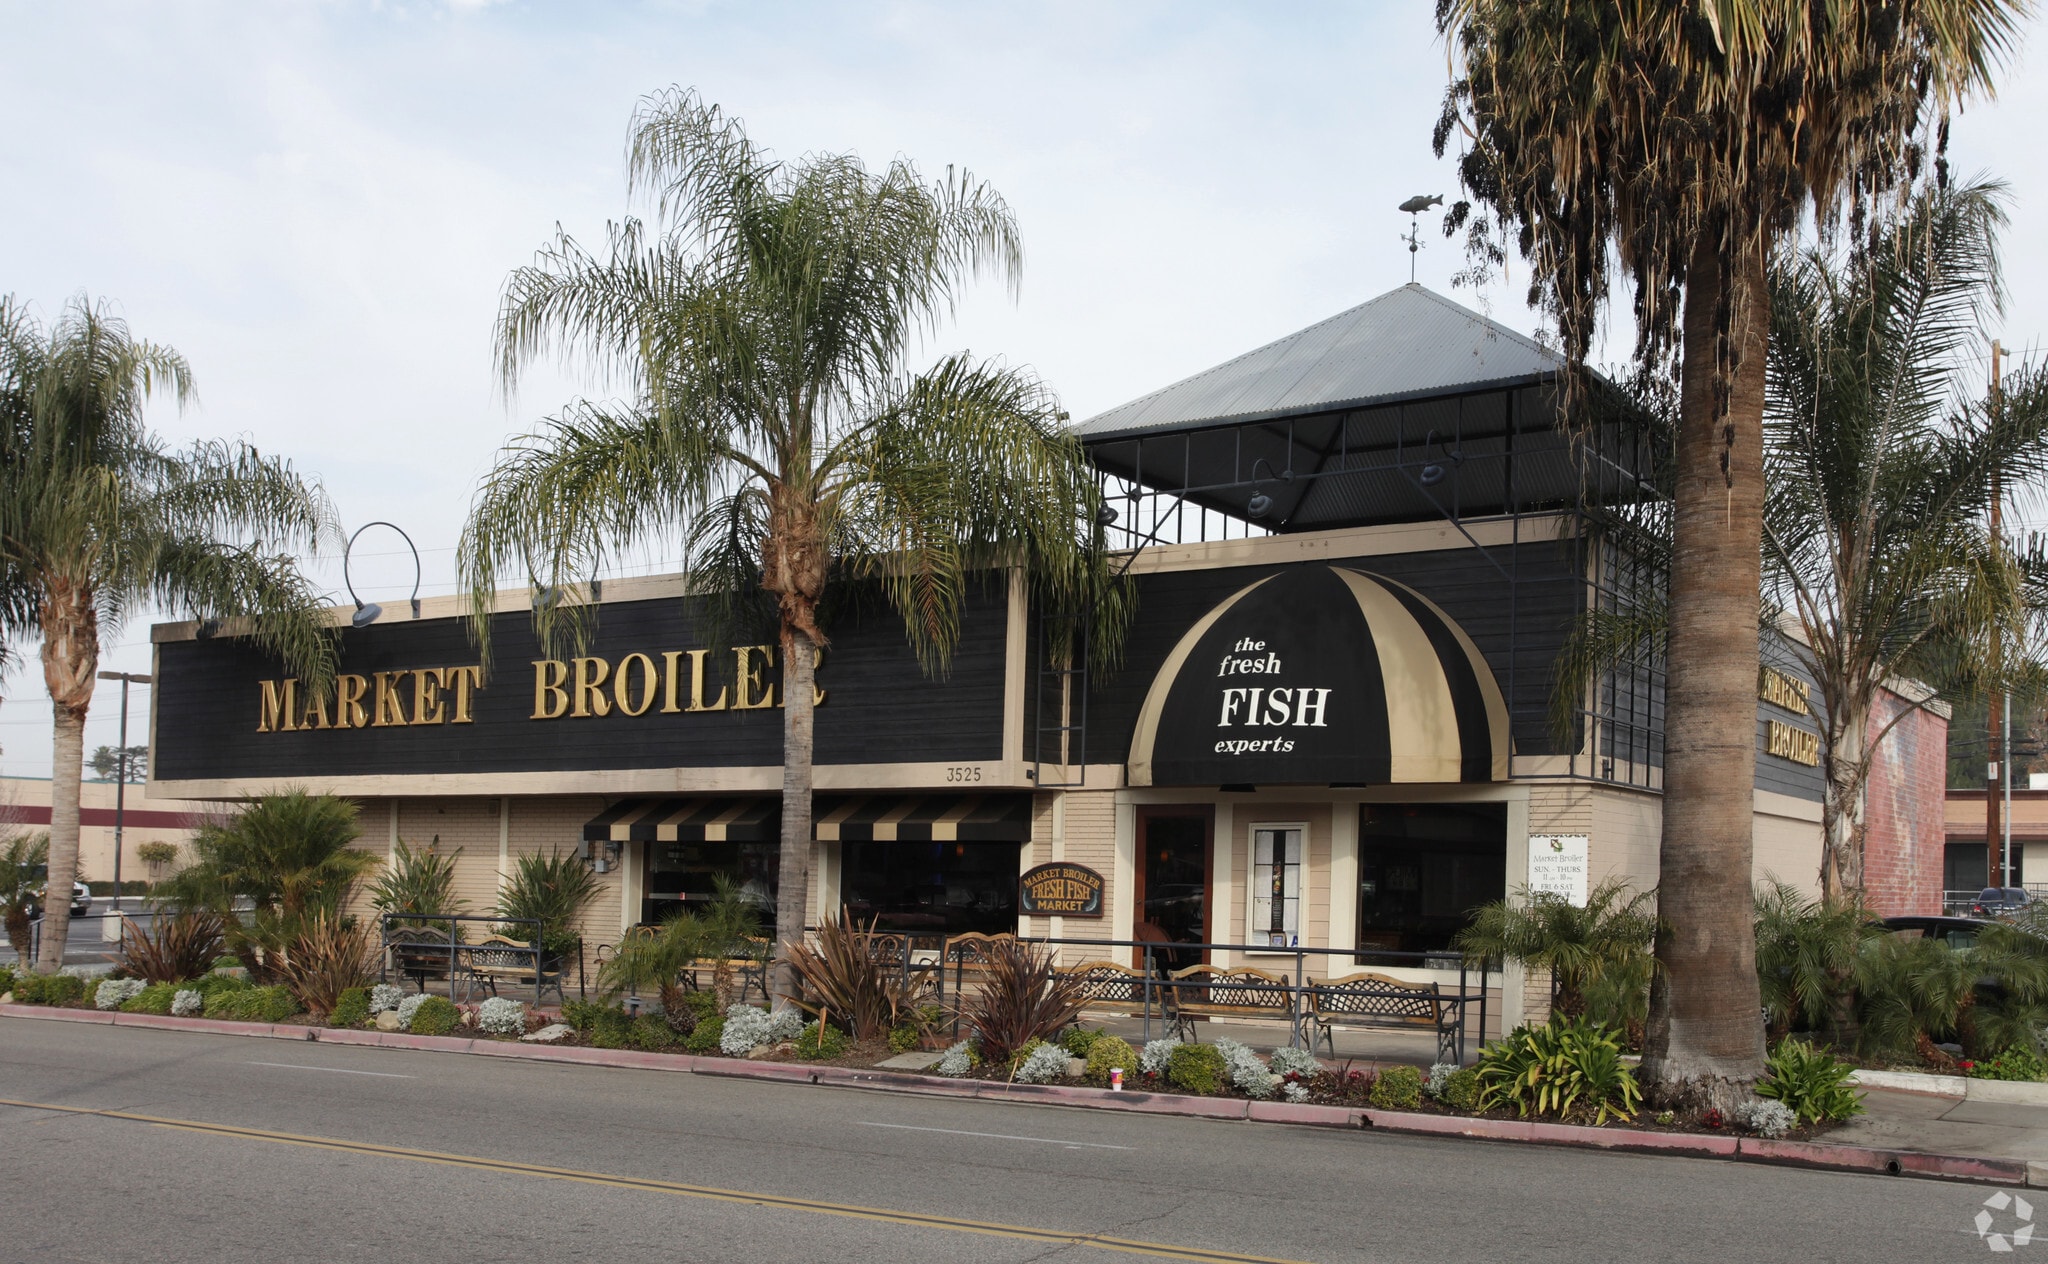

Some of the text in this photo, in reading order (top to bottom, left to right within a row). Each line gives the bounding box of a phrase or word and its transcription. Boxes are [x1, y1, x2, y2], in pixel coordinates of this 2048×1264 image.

[1234, 637, 1266, 652] the
[1217, 652, 1281, 677] fresh
[256, 664, 483, 733] MARKET
[1217, 687, 1333, 727] FISH
[1214, 736, 1295, 755] experts
[1767, 719, 1820, 767] BROILER
[946, 767, 981, 782] 3525
[1533, 855, 1584, 863] Market Broiler
[1024, 868, 1100, 889] MARKET BROILER
[1032, 879, 1091, 900] FRESH FISH
[1037, 901, 1084, 911] MARKET
